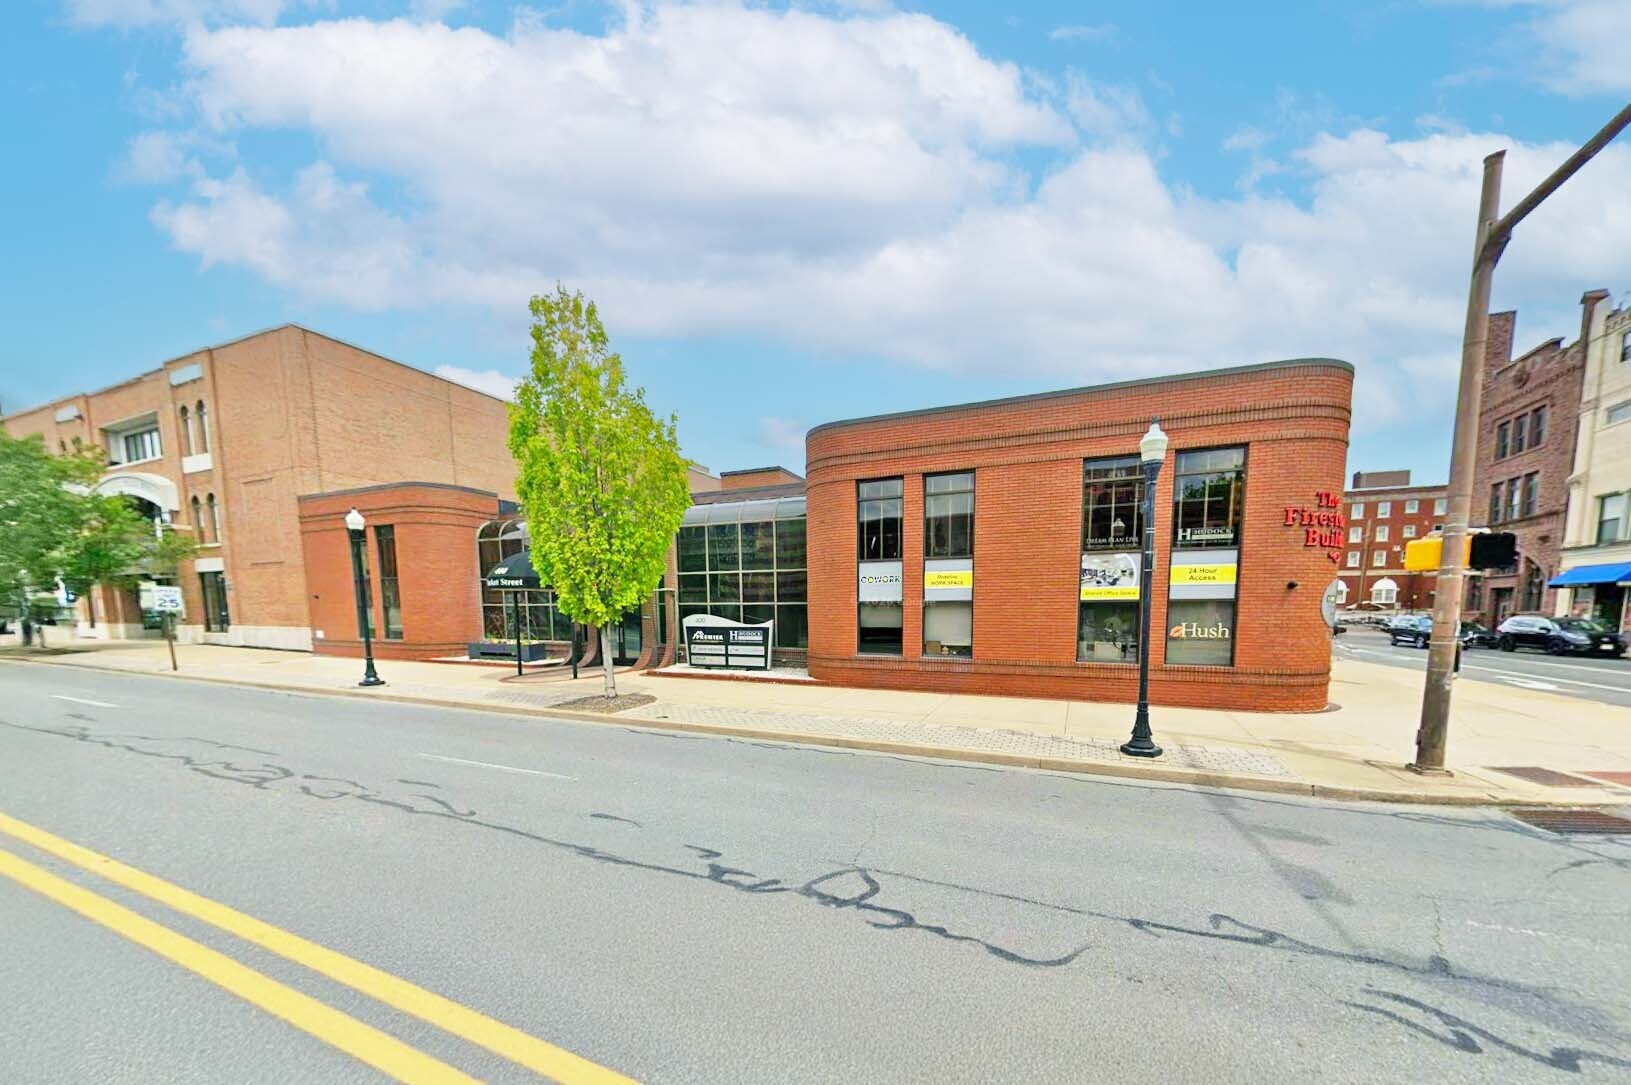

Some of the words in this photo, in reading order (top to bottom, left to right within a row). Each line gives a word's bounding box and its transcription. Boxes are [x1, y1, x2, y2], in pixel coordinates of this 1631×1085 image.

[860, 575, 901, 583] COWORK
[158, 598, 179, 608] 25
[1180, 622, 1229, 638] Hush
